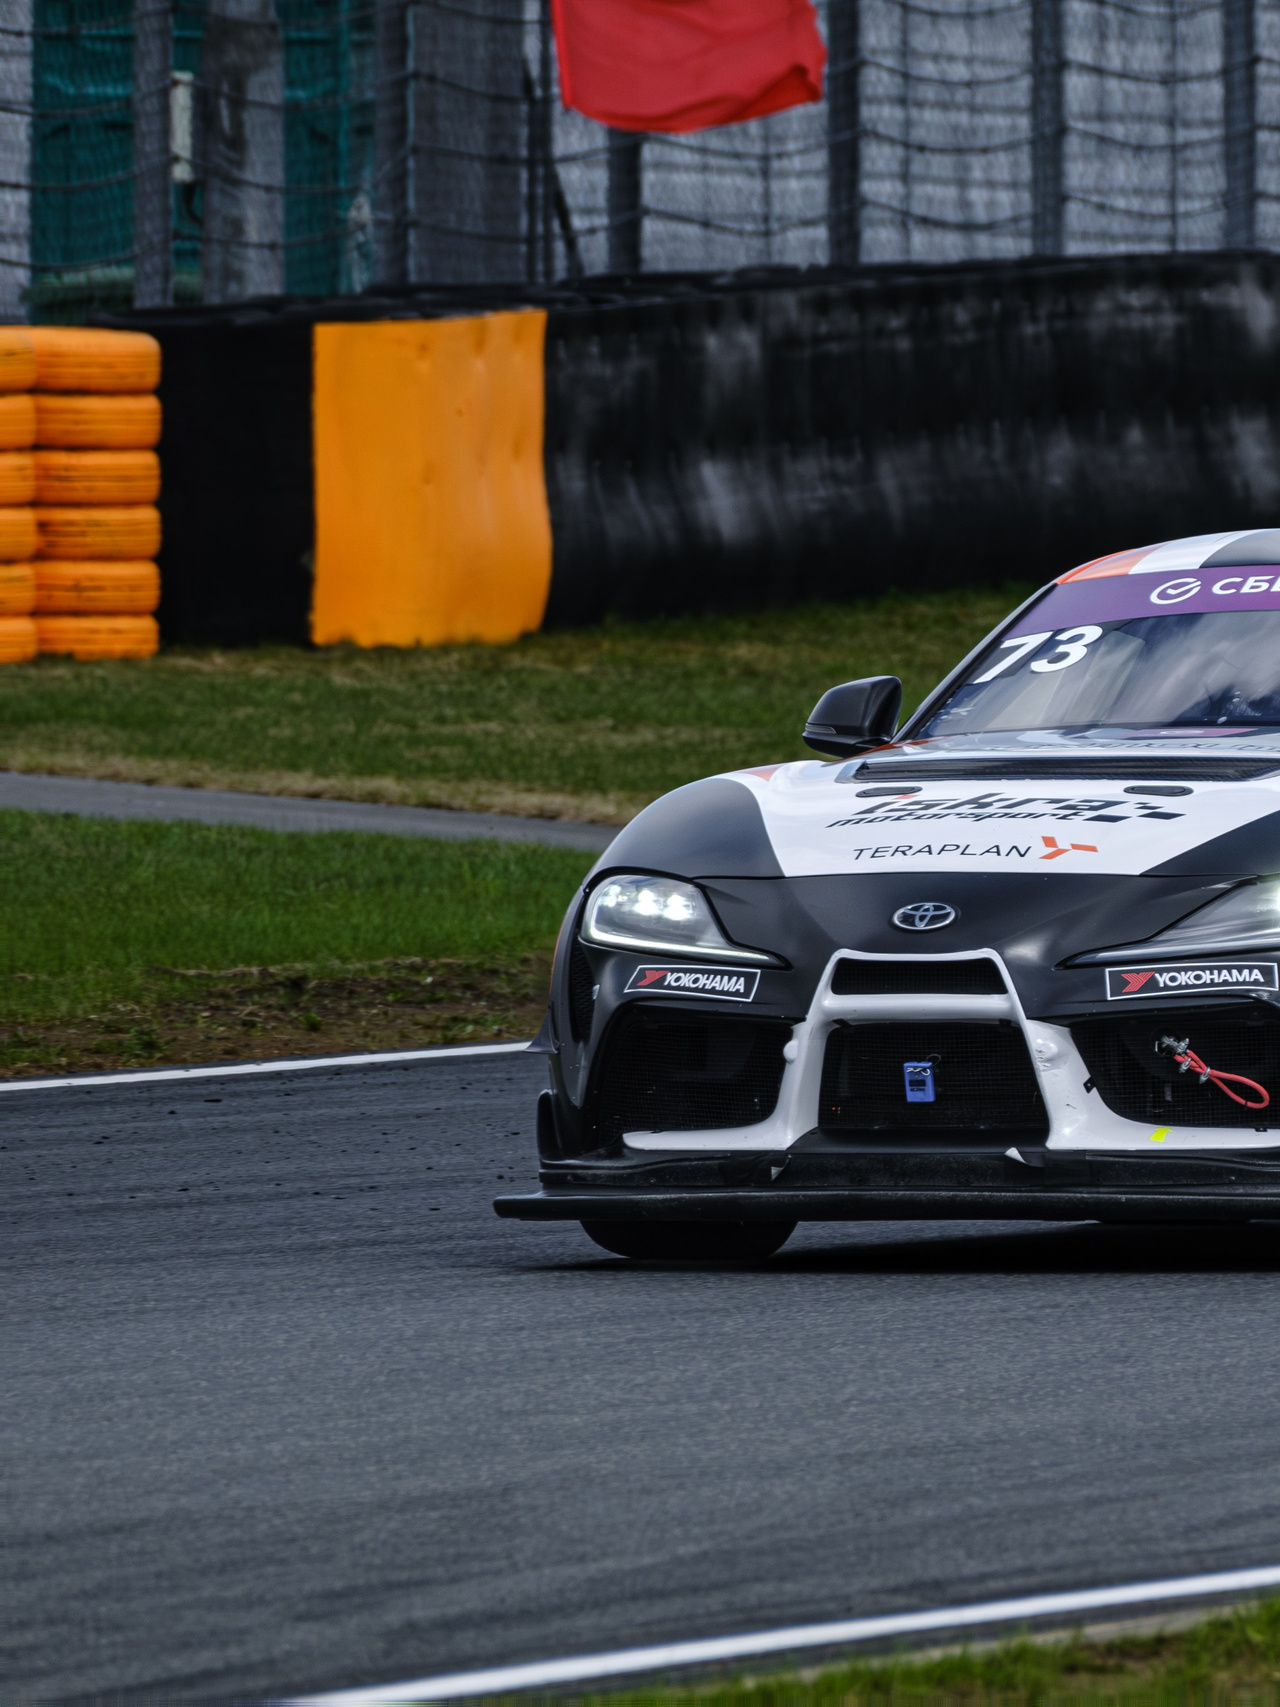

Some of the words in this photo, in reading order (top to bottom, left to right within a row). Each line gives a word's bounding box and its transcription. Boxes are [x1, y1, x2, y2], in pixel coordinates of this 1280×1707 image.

[973, 625, 1104, 684] 73
[852, 792, 1131, 816] iskra
[825, 811, 1088, 829] motorsport
[853, 843, 1032, 861] TERAPLAN
[663, 971, 746, 994] YOKOHAMA
[1154, 968, 1265, 988] YOKOHAMA
